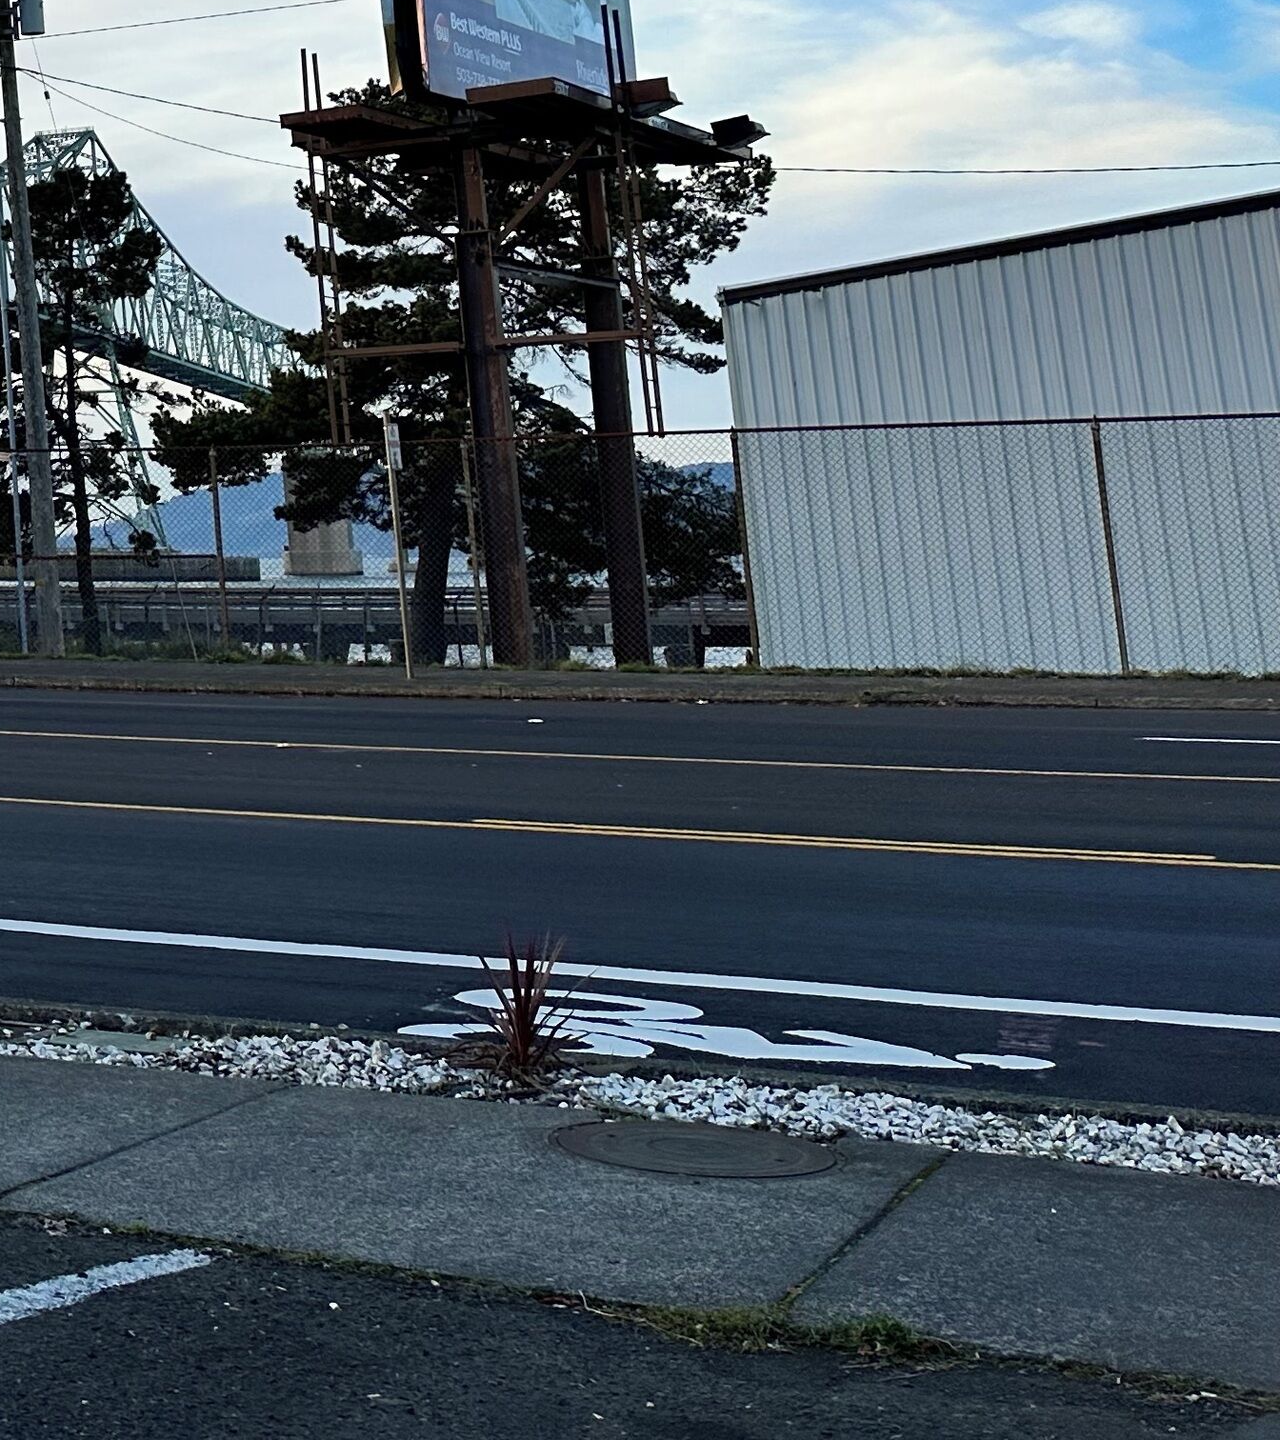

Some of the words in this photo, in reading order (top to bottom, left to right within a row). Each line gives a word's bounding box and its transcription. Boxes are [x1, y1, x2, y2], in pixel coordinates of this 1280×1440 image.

[450, 12, 469, 35] Best
[467, 18, 501, 45] Western
[500, 29, 522, 52] PLUS
[453, 41, 474, 61] Ocean
[474, 48, 491, 67] View
[491, 54, 512, 73] Resort
